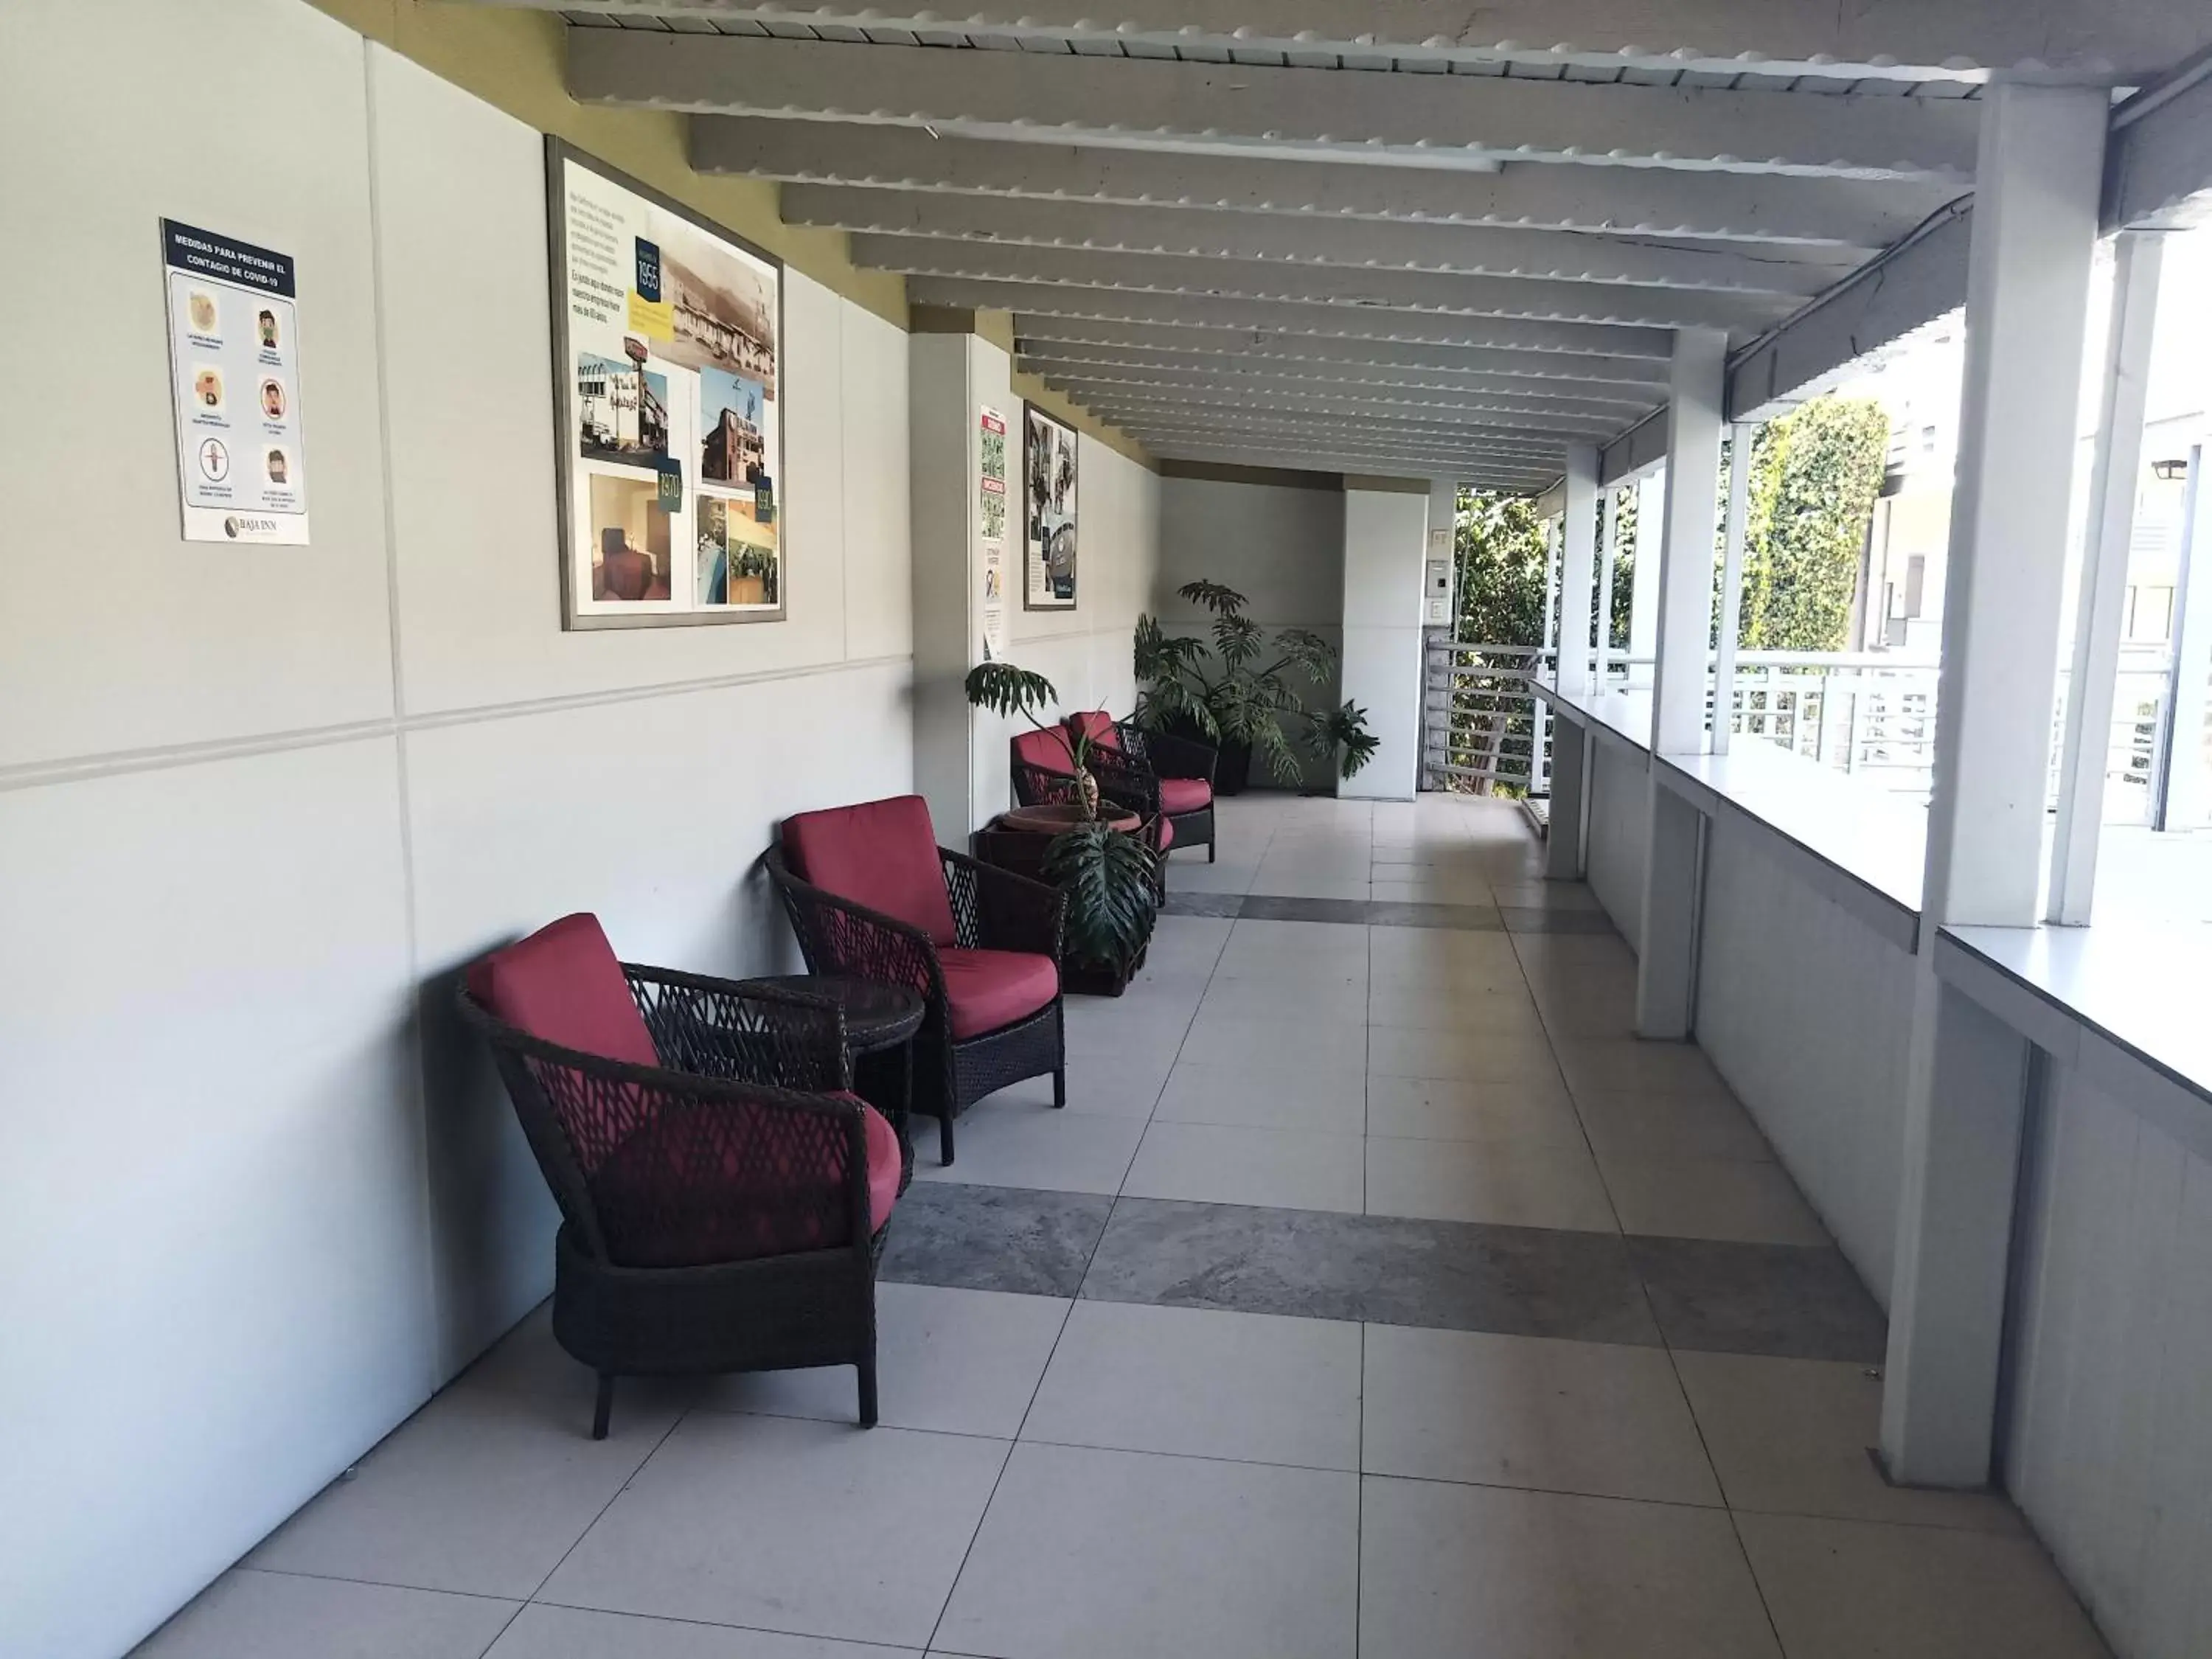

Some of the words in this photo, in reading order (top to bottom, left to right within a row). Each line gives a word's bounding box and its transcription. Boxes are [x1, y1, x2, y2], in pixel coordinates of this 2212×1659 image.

[175, 234, 213, 253] MEDIDAS
[215, 246, 236, 260] PARA
[237, 252, 275, 270] PREVENIR
[276, 263, 286, 274] EL
[186, 254, 230, 274] CONTAGIO
[231, 267, 243, 277] DE
[244, 271, 278, 287] COVID-19
[638, 260, 658, 290] 1955
[239, 518, 260, 531] BAJA
